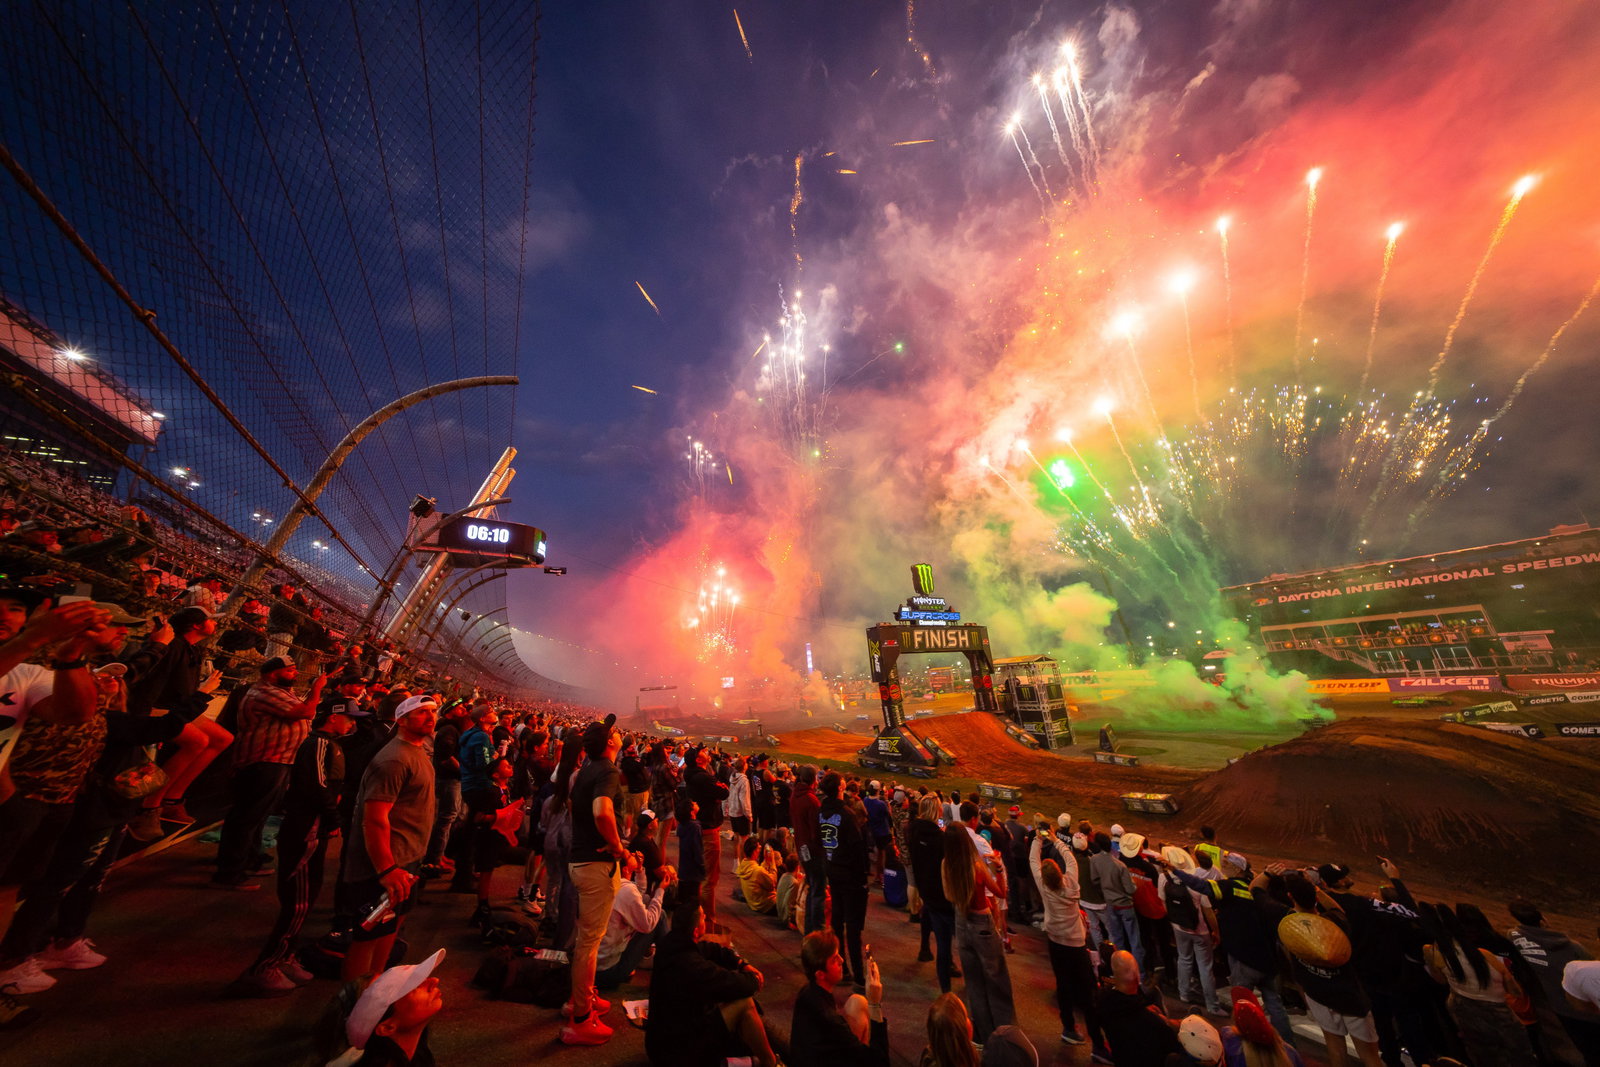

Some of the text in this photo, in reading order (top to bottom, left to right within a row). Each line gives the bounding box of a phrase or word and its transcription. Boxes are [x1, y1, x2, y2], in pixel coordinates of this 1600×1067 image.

[467, 525, 509, 543] 06:10
[1278, 552, 1600, 603] DAYTONA INTERNATIONAL SPEEDW
[913, 597, 945, 605] MONSTER
[901, 611, 960, 620] SUPERCROSS
[913, 629, 969, 649] FINISH
[1400, 677, 1489, 687] FALKEN
[1532, 677, 1597, 686] TRIUMPH
[1530, 696, 1565, 704] COMETIC
